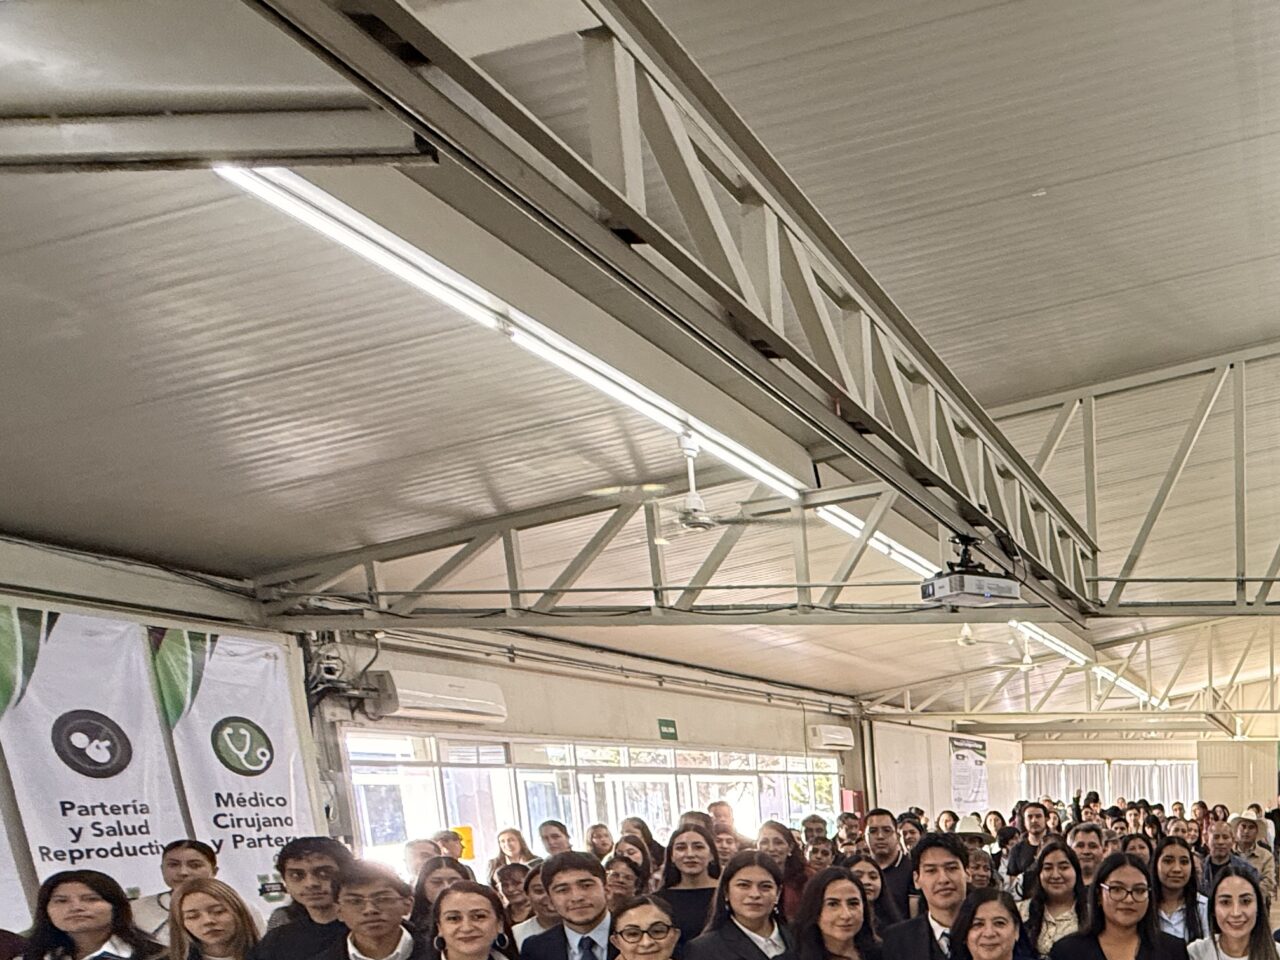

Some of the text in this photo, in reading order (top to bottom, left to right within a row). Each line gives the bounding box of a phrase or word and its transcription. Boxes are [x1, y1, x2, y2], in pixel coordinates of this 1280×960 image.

[59, 799, 150, 817] Partería
[214, 791, 287, 808] Médico
[68, 819, 151, 843] y Salud
[212, 813, 294, 832] Cirujano
[211, 834, 297, 855] y Parter
